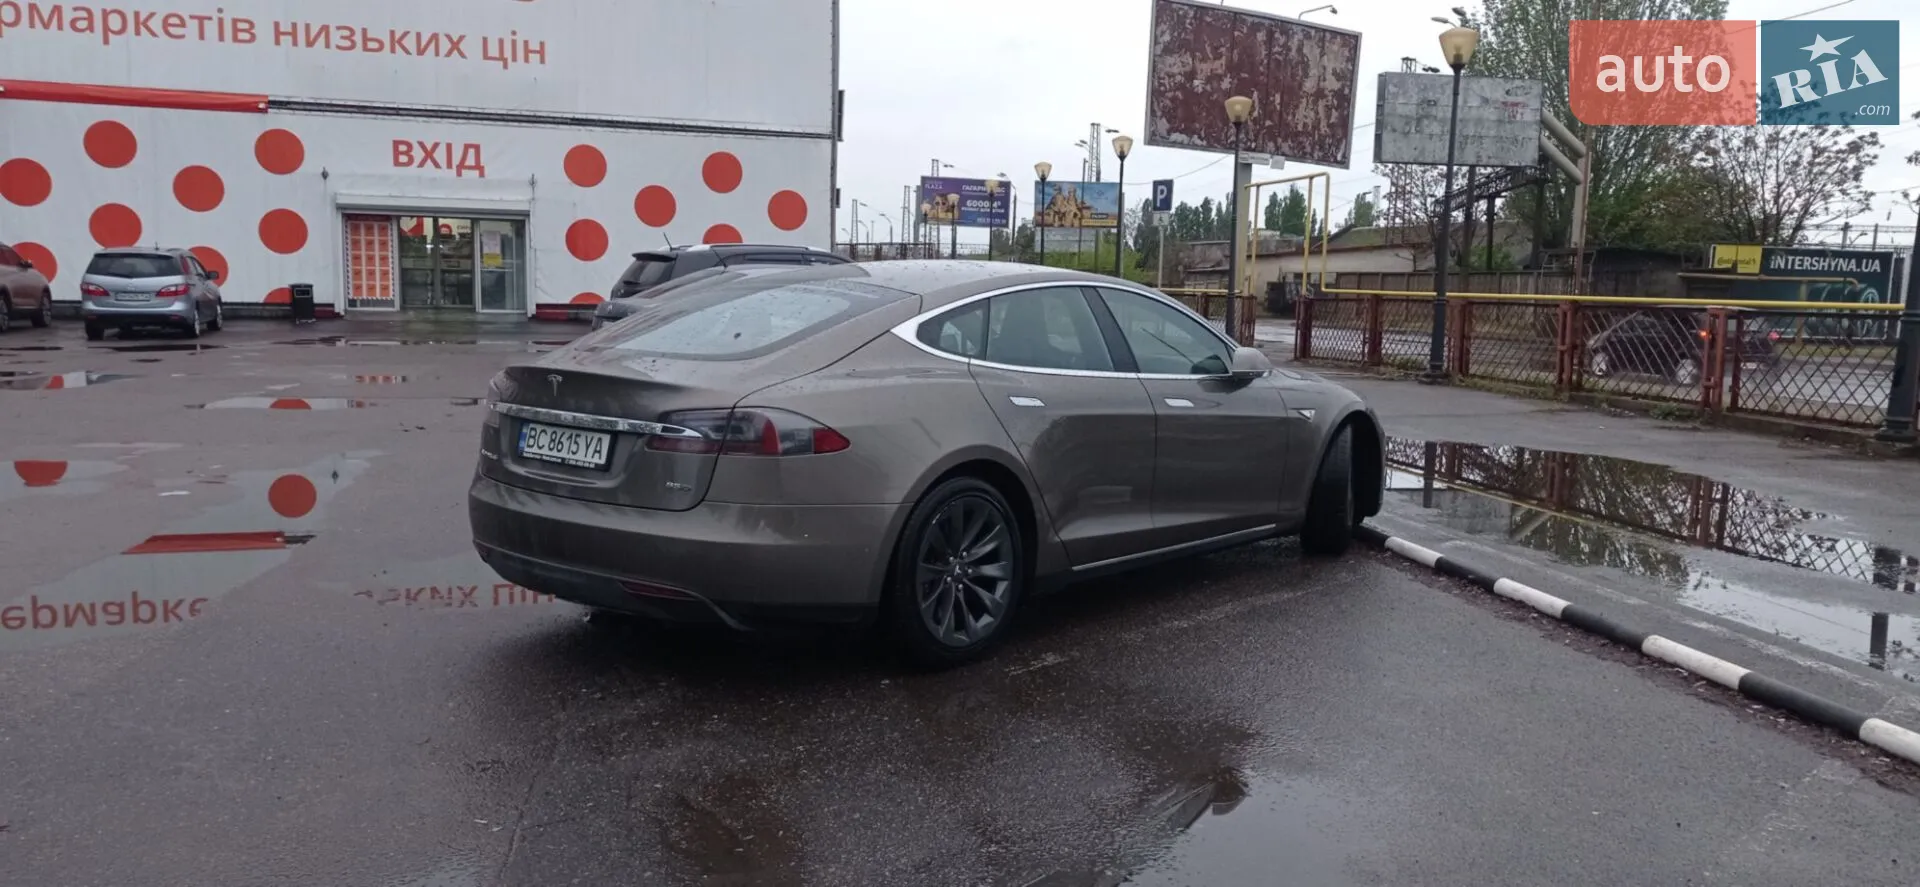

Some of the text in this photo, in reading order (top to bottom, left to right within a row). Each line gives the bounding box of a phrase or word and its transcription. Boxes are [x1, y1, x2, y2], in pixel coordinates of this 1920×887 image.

[0, 0, 547, 70] рмаркетів низьких цін
[392, 139, 486, 178] ВХІД
[1156, 184, 1168, 208] P
[526, 426, 603, 461] BC 8615 YA
